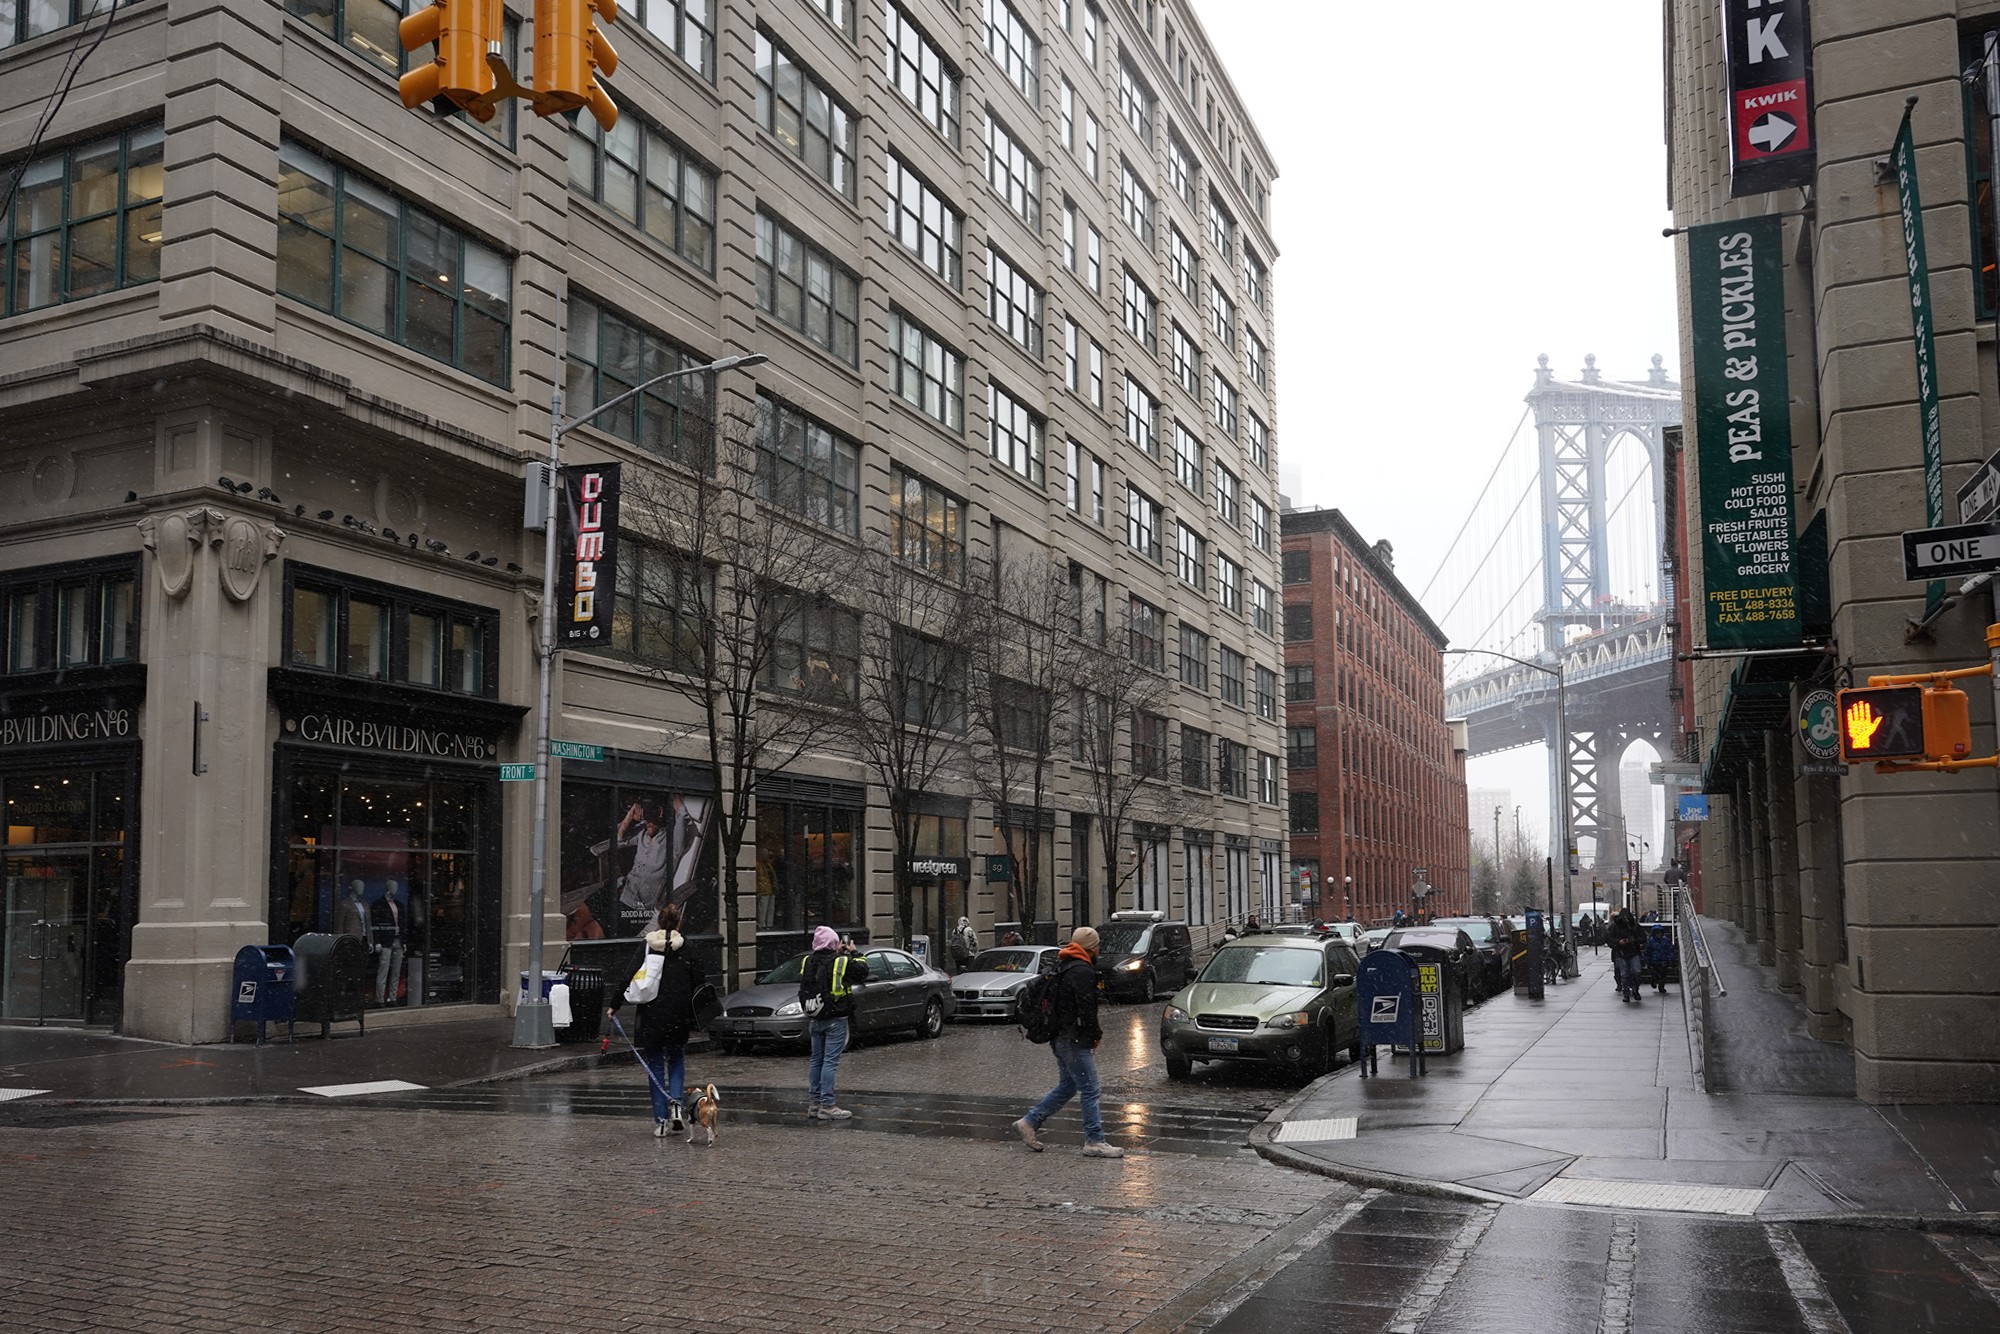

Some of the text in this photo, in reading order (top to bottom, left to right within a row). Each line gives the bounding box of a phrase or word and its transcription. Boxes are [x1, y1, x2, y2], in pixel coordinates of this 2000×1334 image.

[1744, 89, 1798, 109] KWIK
[1719, 232, 1762, 463] PEAS & PICKLES
[1751, 473, 1785, 484] SUSHI
[1731, 484, 1786, 498] HOT FOOD
[1964, 471, 1998, 518] ONE WAY
[1725, 495, 1787, 509] COLD FOOD
[1750, 506, 1787, 518] SALAD
[1709, 517, 1788, 533] FRESH FRUITS
[1716, 529, 1789, 544] VEGETABLES
[573, 472, 606, 622] DUMBO
[1735, 540, 1789, 553] FLOWERS
[1931, 540, 1982, 563] ONE
[1753, 552, 1790, 563] DELI &
[1737, 563, 1790, 576] GROCERY
[1709, 587, 1794, 601] FREE DELIVERY
[1719, 598, 1794, 612] TEL. 488-8336
[1718, 610, 1796, 623] FAX. 488-7658
[1804, 693, 1839, 711] BROOKLY
[551, 742, 595, 759] WASHINGTON
[1806, 738, 1840, 757] BREWER
[501, 766, 526, 778] FRONT
[1680, 812, 1709, 820] Coffee
[906, 860, 957, 876] weetgreen
[992, 864, 1003, 872] sg
[621, 910, 638, 918] RODD
[805, 993, 823, 1012] NIKE
